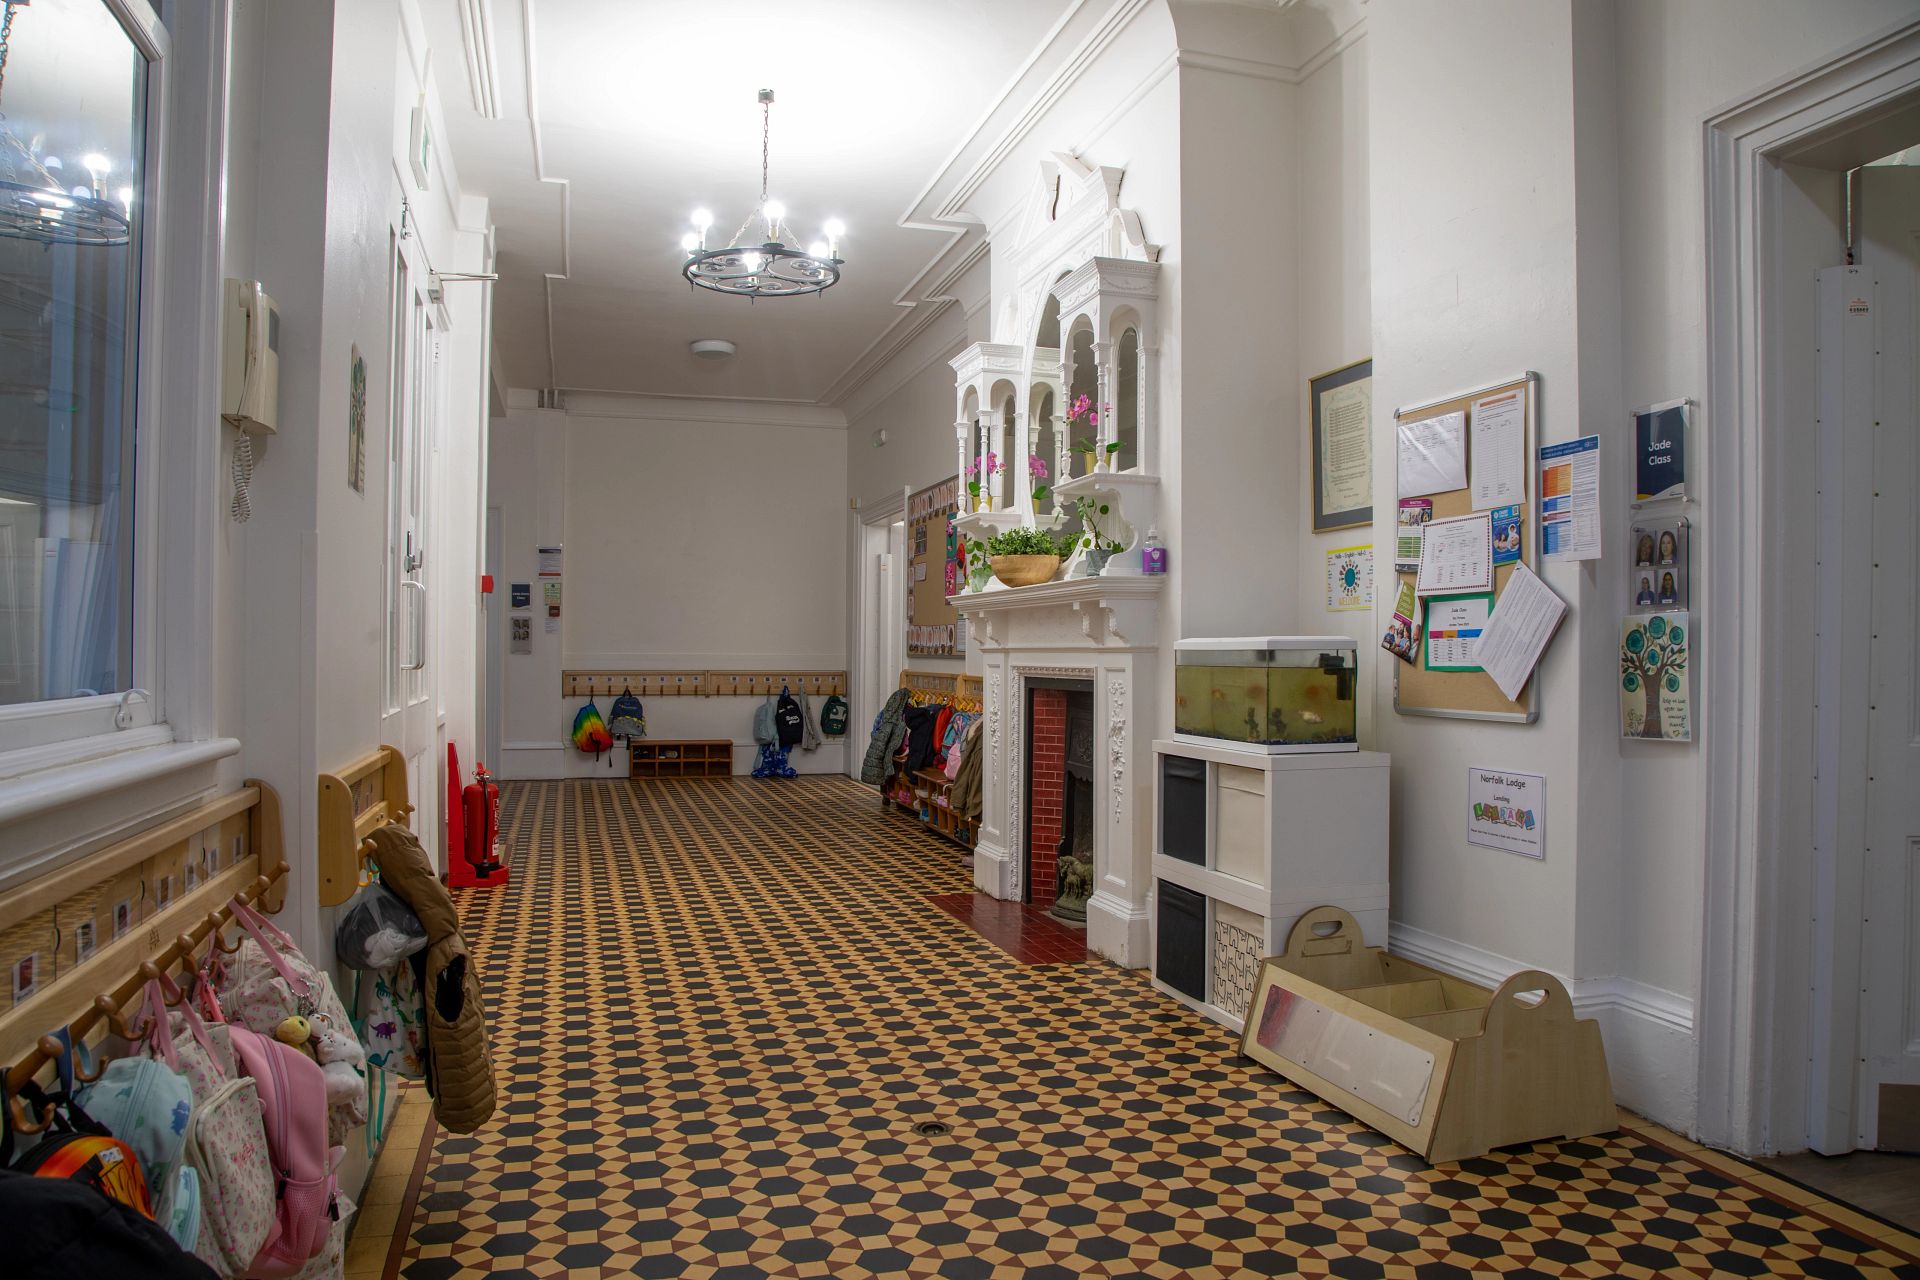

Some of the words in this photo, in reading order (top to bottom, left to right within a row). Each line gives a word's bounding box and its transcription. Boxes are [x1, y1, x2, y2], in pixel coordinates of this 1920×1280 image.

[1648, 440, 1672, 451] Jade
[1648, 455, 1672, 466] Class
[1339, 596, 1360, 605] WELCOME
[1480, 774, 1504, 785] Norfolk
[1506, 777, 1526, 789] Lodge
